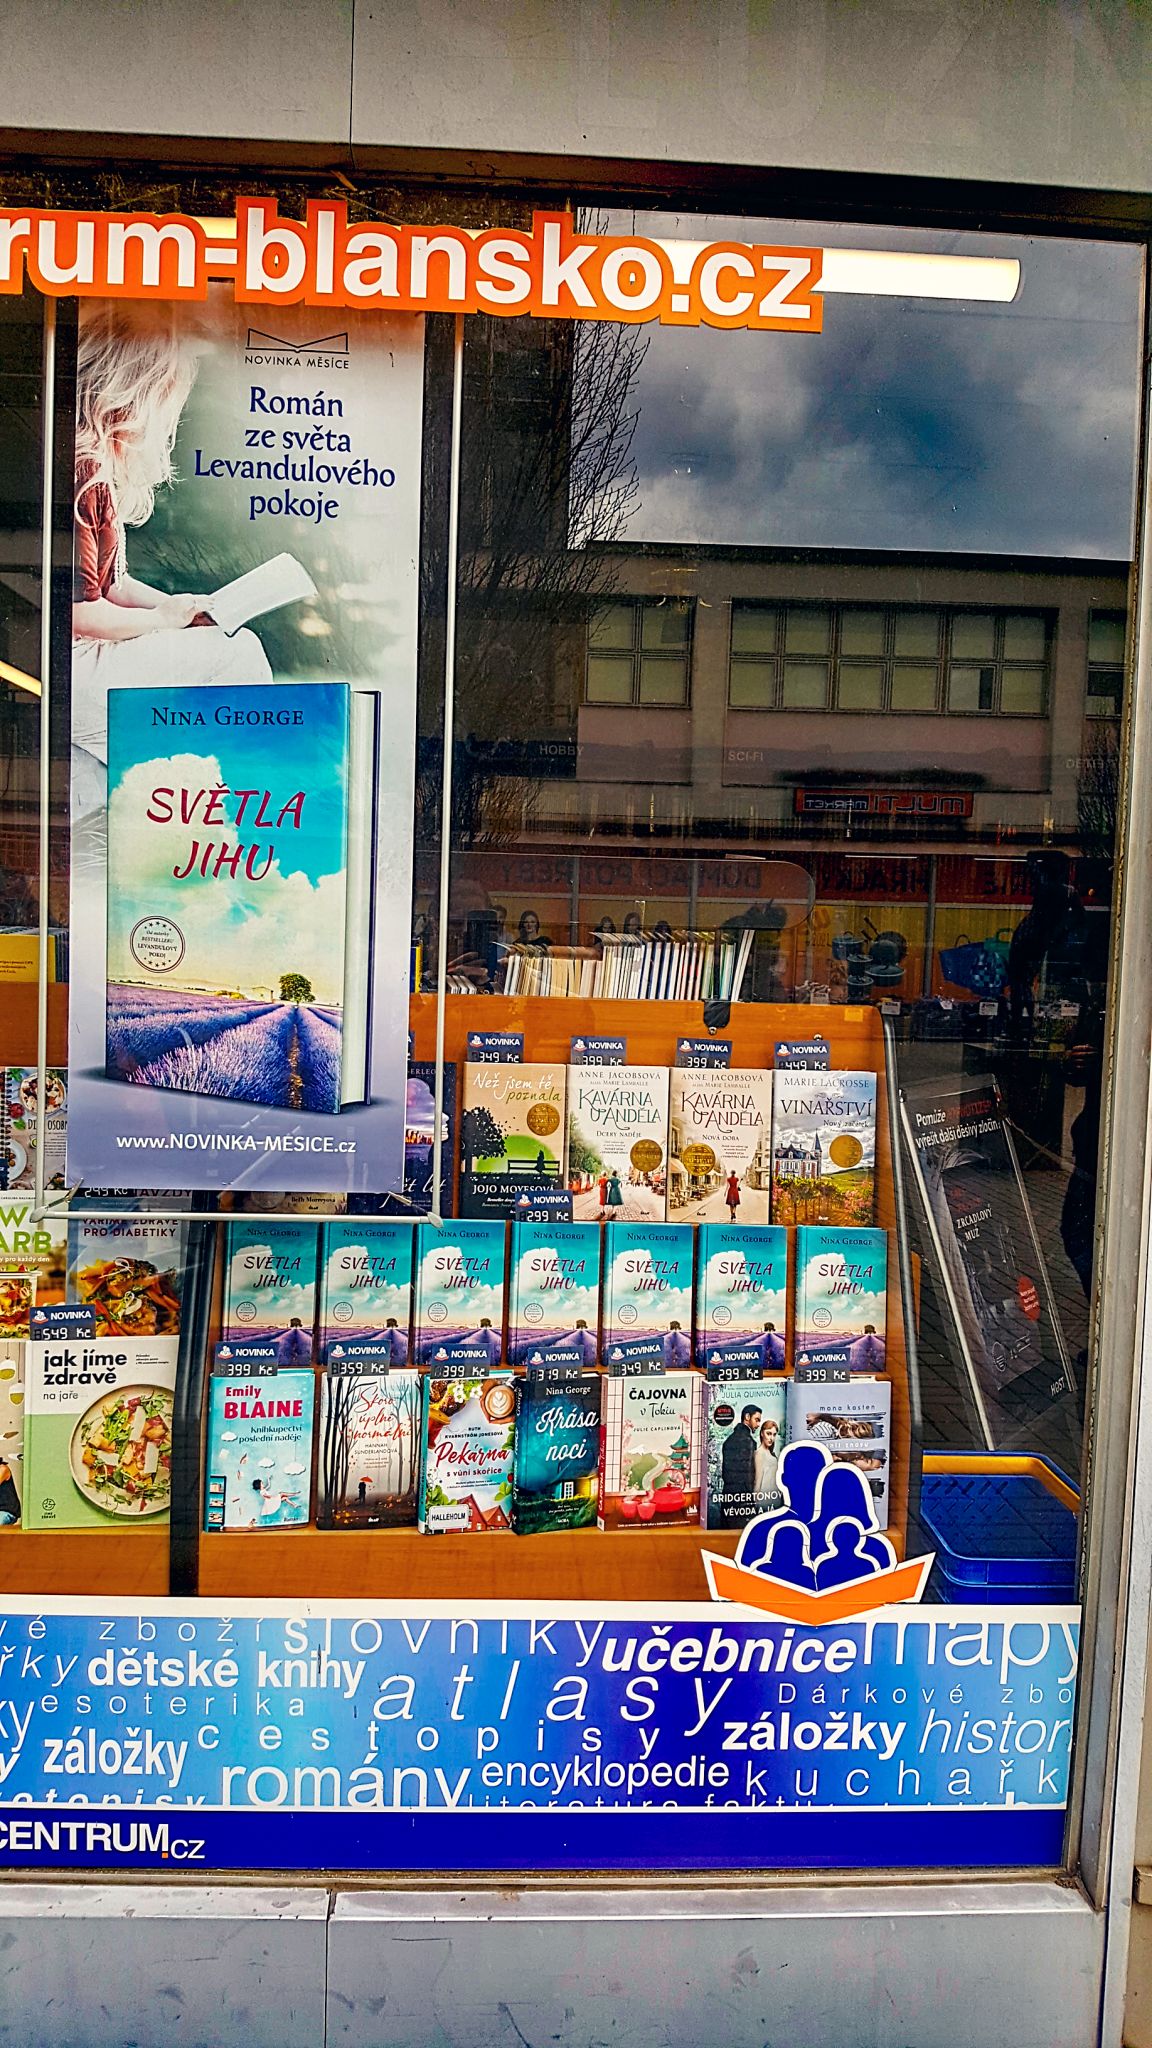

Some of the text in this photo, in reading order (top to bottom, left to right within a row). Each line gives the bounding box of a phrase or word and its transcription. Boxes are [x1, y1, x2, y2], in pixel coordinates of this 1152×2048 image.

[245, 353, 350, 369] NOVINKA MĚSÍCE
[249, 387, 344, 417] Román
[245, 425, 351, 453] ze světa
[194, 450, 396, 488] Levandulového
[249, 489, 339, 524] pokoje
[539, 744, 584, 757] HOBBY
[146, 783, 306, 829] SVĚTLA
[173, 841, 275, 881] JIHU
[792, 1045, 827, 1054] NOVINKA
[785, 1061, 807, 1070] 449
[473, 1071, 552, 1099] Než jsem tě
[784, 1077, 869, 1087] MARIE LACROSSE
[506, 1086, 562, 1104] poznala
[579, 1088, 653, 1110] KAVÁRNA
[682, 1091, 756, 1112] KAVÁRNA
[780, 1098, 873, 1116] VINAŘSTVÍ
[602, 1108, 661, 1130] ANDĚLA
[705, 1110, 763, 1133] ANDĚLA
[915, 1109, 946, 1127] Pomůže
[979, 1118, 999, 1134] zločin
[472, 1184, 497, 1194] JOJO
[533, 1196, 570, 1204] NOVINKA
[527, 1210, 569, 1222] 299 Kč
[956, 1203, 992, 1229] ZRCADLOVÝ
[84, 1228, 176, 1236] PRO DIABETIKY
[964, 1224, 980, 1241] MUŽ
[435, 1255, 491, 1271] SVĚTLA
[531, 1256, 586, 1272] SVĚTLA
[624, 1258, 679, 1274] SVĚTLA
[718, 1260, 773, 1275] SVĚTLA
[818, 1262, 873, 1278] SVĚTLA
[444, 1275, 480, 1289] JIHU
[540, 1276, 575, 1290] JIHU
[634, 1278, 669, 1291] JIHU
[727, 1280, 763, 1293] JIHU
[827, 1282, 863, 1296] JIHU
[51, 1310, 91, 1320] NOVINKA
[43, 1328, 68, 1340] 549
[235, 1348, 275, 1357] NOVINKA
[348, 1346, 386, 1355] NOVINKA
[451, 1350, 488, 1359] NOVINKA
[545, 1352, 580, 1362] NOVINKA
[626, 1345, 661, 1356] NOVINKA
[724, 1351, 759, 1361] NOVINKA
[43, 1350, 77, 1372] jak
[82, 1349, 127, 1372] jíme
[340, 1362, 385, 1374] 359 Kč
[620, 1361, 661, 1375] 349 Kč
[43, 1367, 117, 1385] zdravě
[228, 1363, 273, 1376] 399 Kč
[442, 1365, 485, 1377] 399 Kč
[565, 1368, 578, 1379] Kč
[718, 1368, 759, 1381] 299 Kč
[59, 1390, 79, 1402] jaře
[225, 1385, 262, 1399] Emily
[354, 1385, 395, 1413] Skoro
[545, 1386, 592, 1397] Nina George
[629, 1387, 687, 1401] ČAJOVNA
[721, 1390, 780, 1399] JULIA QUINNOVÁ
[224, 1400, 303, 1420] BLAINE
[640, 1402, 676, 1417] v Tokiu
[250, 1424, 302, 1434] Knihkupectví
[535, 1407, 600, 1436] Krása
[239, 1434, 302, 1444] poslední naděje
[434, 1441, 511, 1468] Pekárna
[545, 1438, 588, 1462] noci
[472, 1466, 503, 1475] skořice
[432, 1512, 466, 1522] HALLEHOLM
[724, 1506, 756, 1516] VÉVODA
[601, 1626, 856, 1674] učebnice
[87, 1648, 366, 1697] dětské knihy
[374, 1661, 733, 1737] atlasy
[778, 1683, 964, 1705] Dárkové
[40, 1694, 304, 1717] esoterika
[198, 1720, 660, 1760] cestopisy
[721, 1710, 906, 1760] záložky
[43, 1726, 188, 1787] záložky
[223, 1752, 472, 1807] romány
[481, 1755, 730, 1796] encyklopedie
